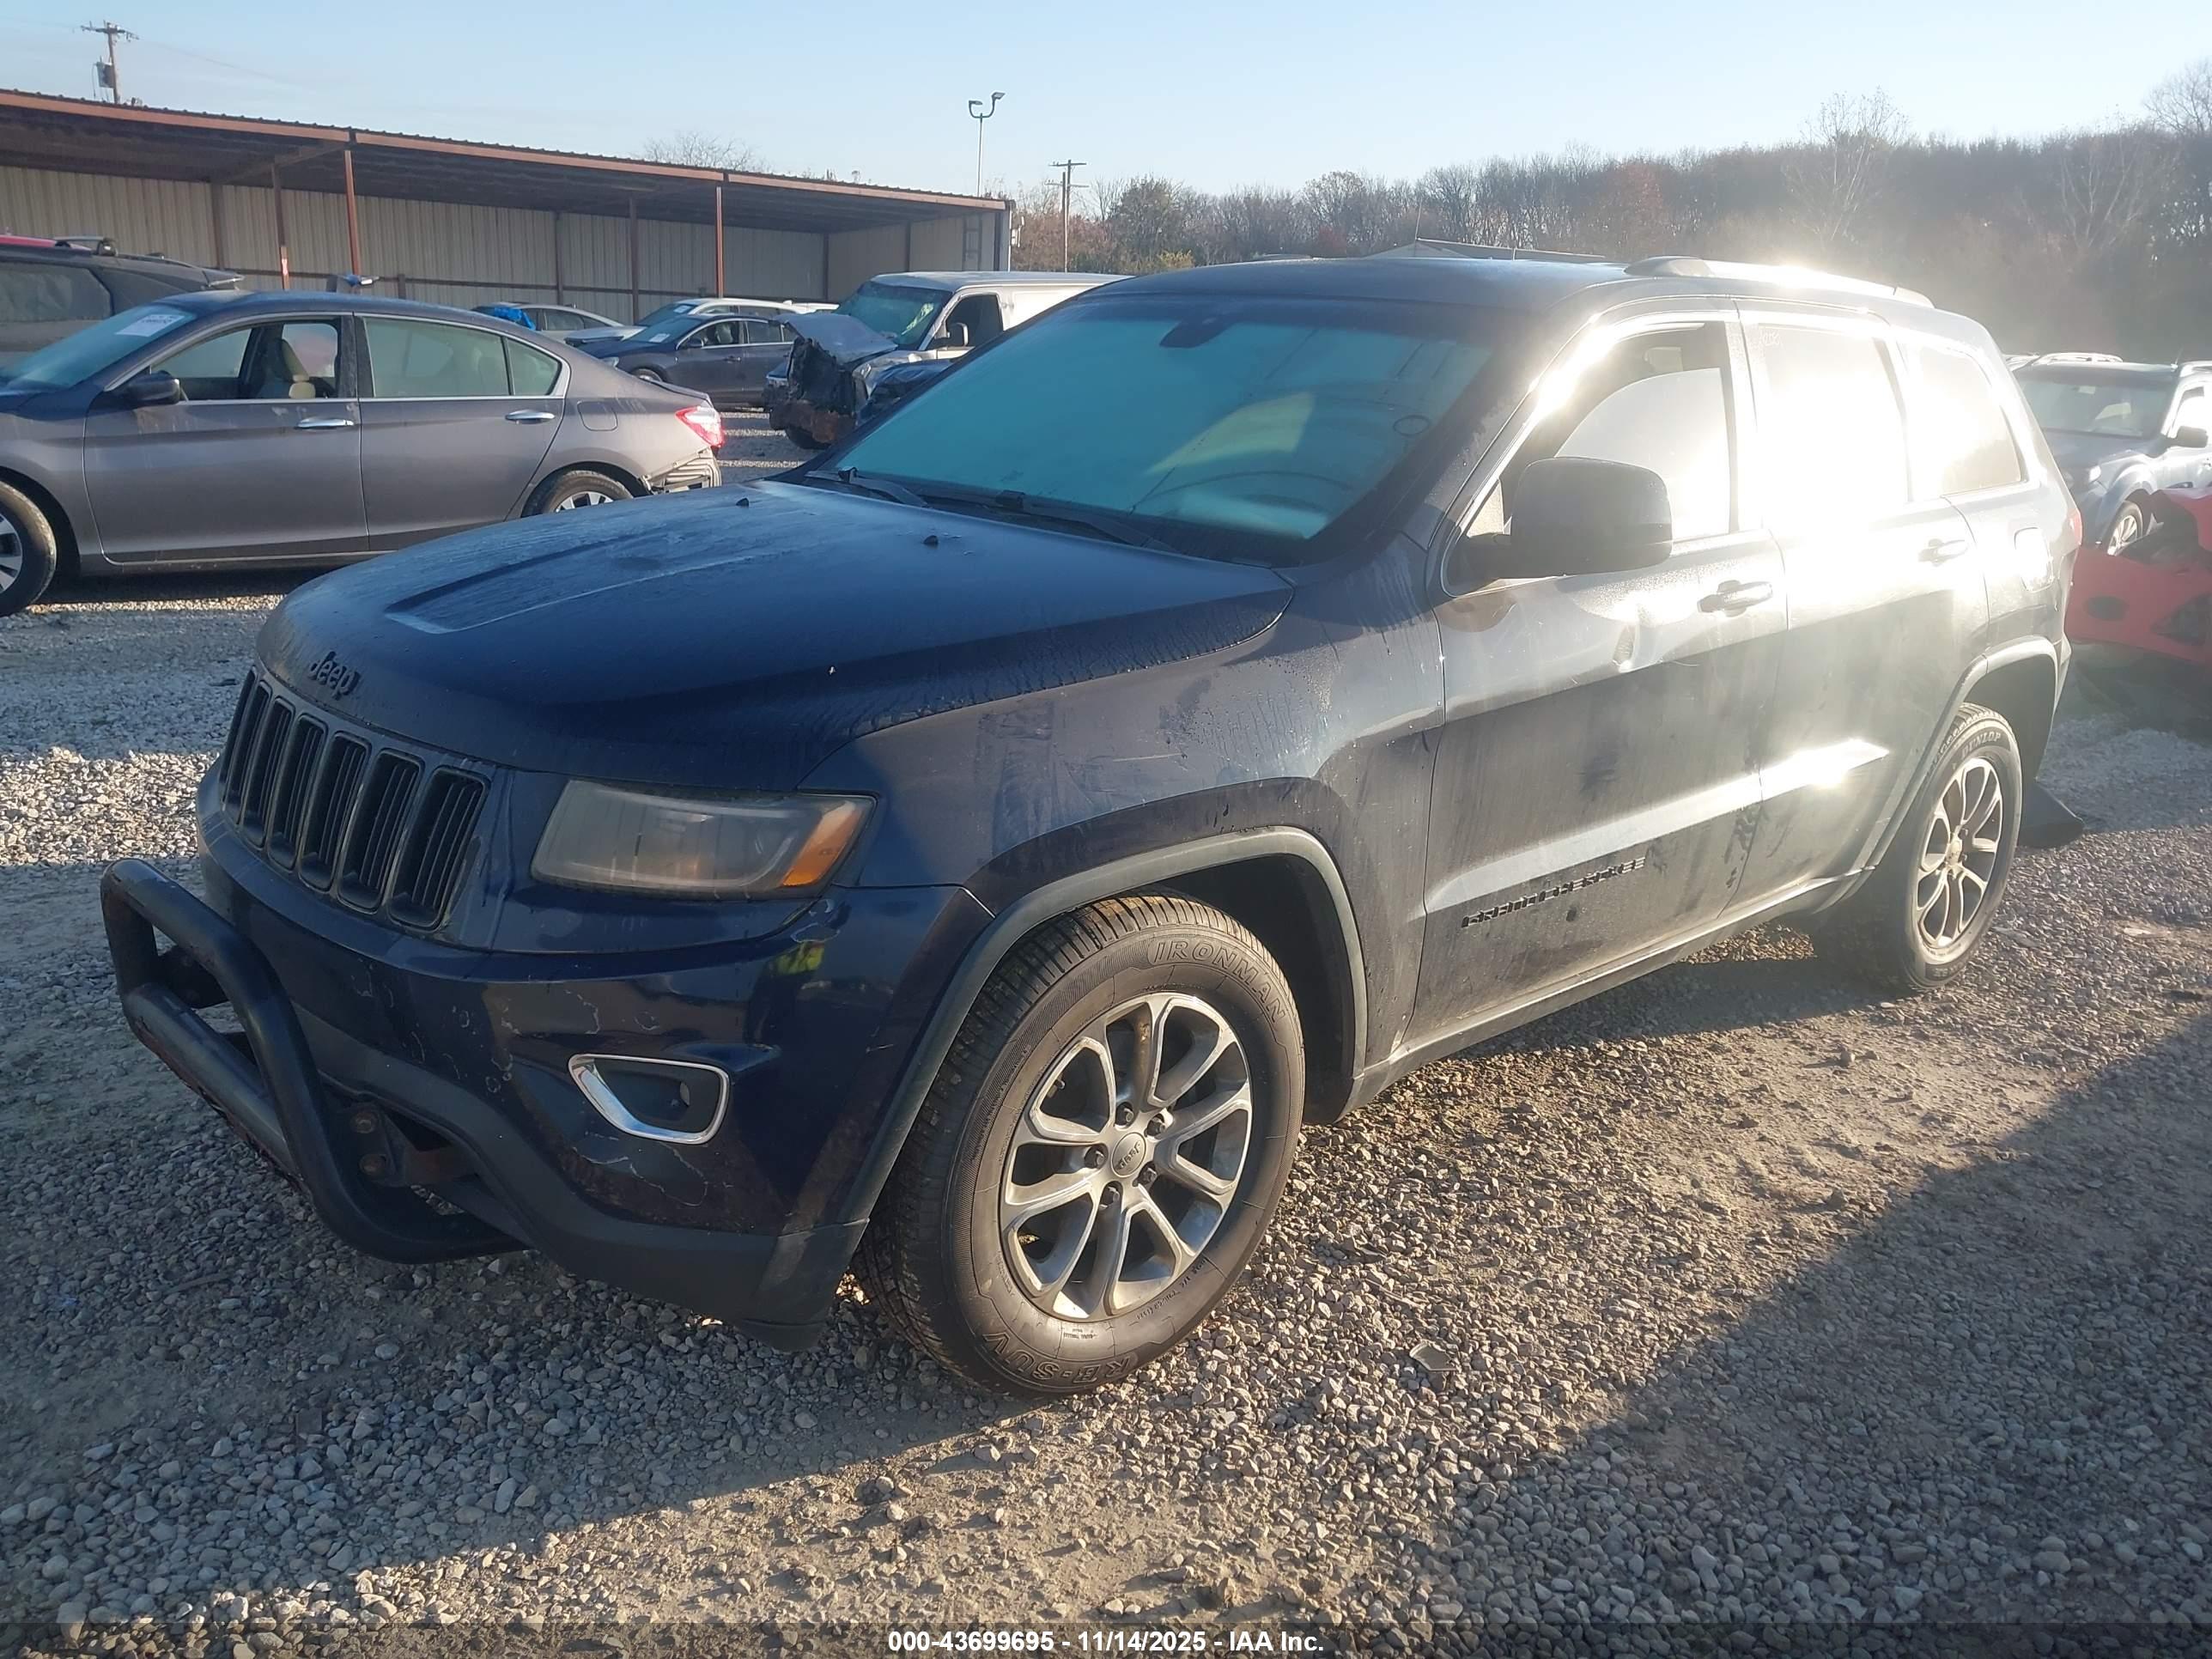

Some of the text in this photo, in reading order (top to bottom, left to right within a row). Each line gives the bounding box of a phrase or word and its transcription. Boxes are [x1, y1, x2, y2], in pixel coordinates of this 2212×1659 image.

[309, 651, 362, 701] Jeep
[1961, 731, 2002, 761] DUNLOP
[1539, 856, 1646, 903] CHEROKEE
[1153, 940, 1286, 1024] IRONMAN
[1114, 1139, 1142, 1170] Jeep
